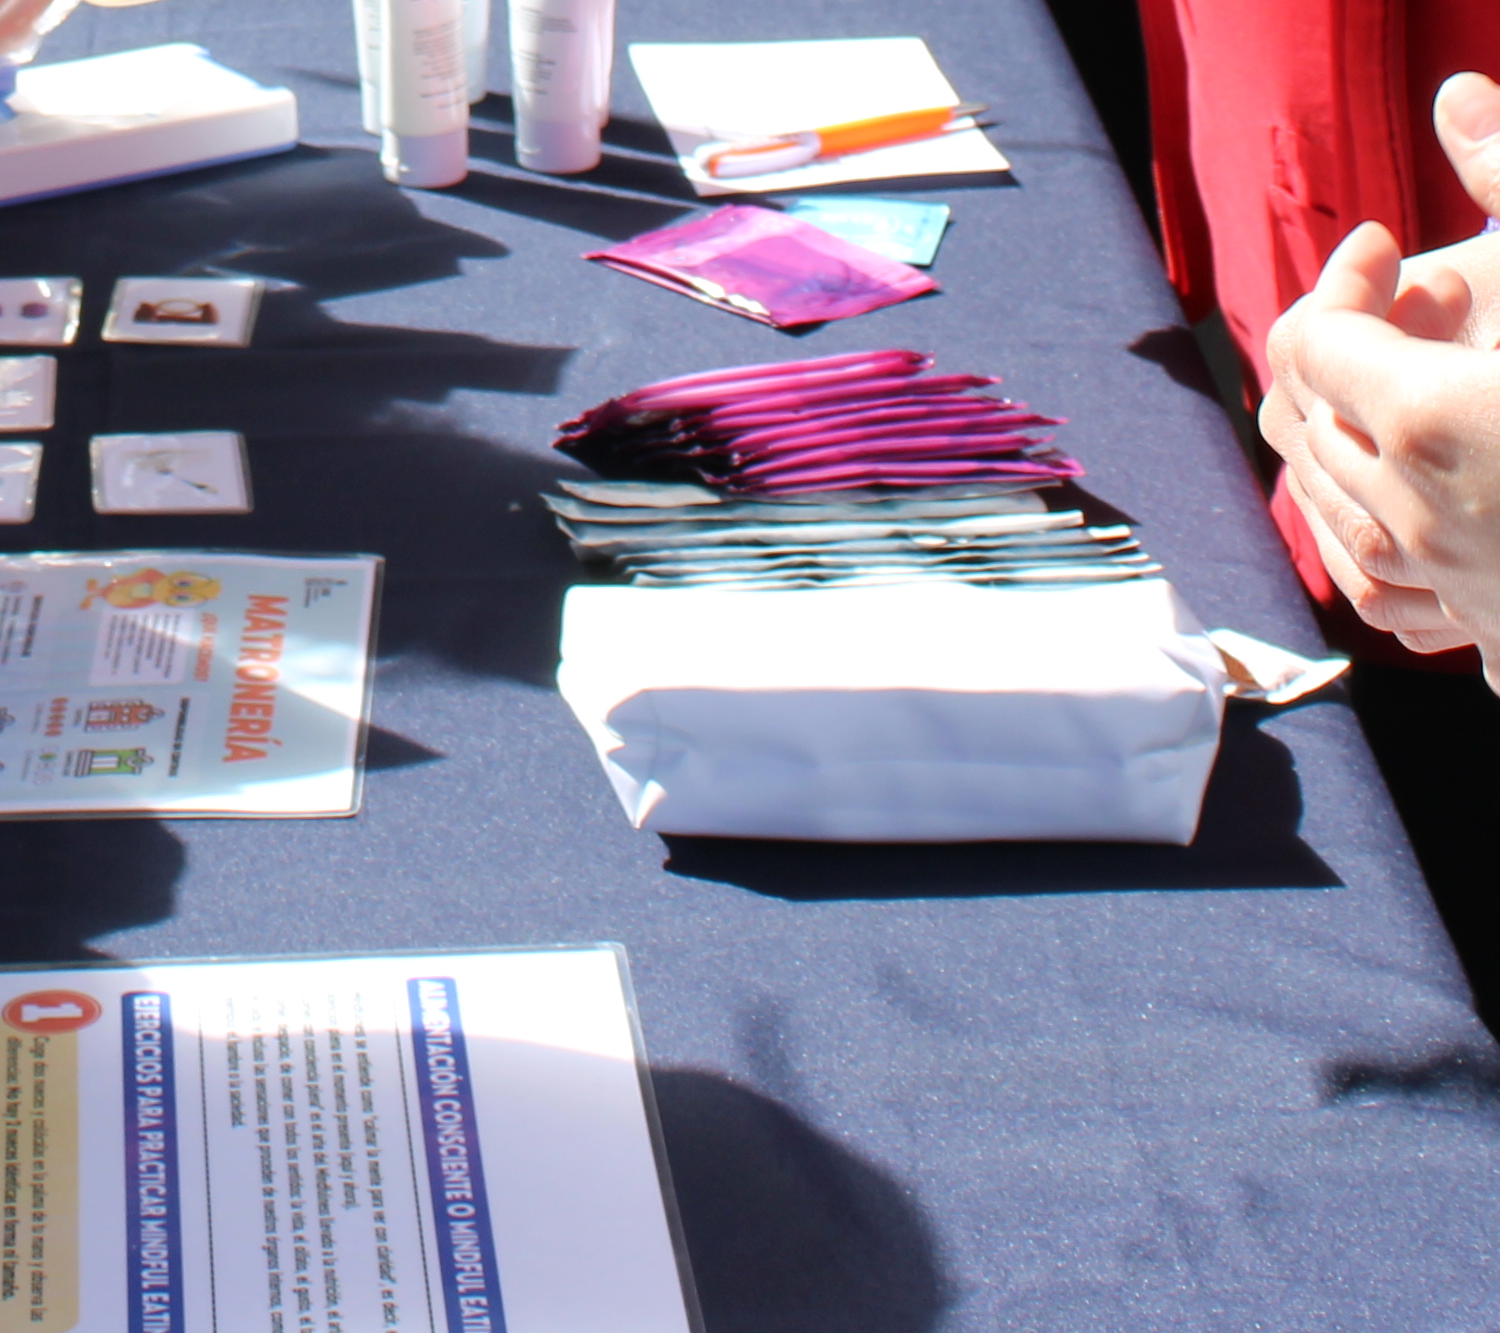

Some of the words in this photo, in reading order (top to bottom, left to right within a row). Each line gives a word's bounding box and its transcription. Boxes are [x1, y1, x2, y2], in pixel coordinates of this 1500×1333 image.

[223, 594, 290, 763] MATRONERÍA
[22, 1003, 83, 1024] 1
[136, 995, 161, 1083] EJERCICIOS
[422, 980, 462, 1095] ALIMENTACIÓN
[138, 1086, 162, 1127] PARA
[139, 1131, 164, 1216] PRACTICAR
[436, 1099, 469, 1199] CONSCIENTE
[447, 1203, 471, 1217] O
[142, 1220, 167, 1287] MINDFUL
[449, 1220, 482, 1295] MINDFUL
